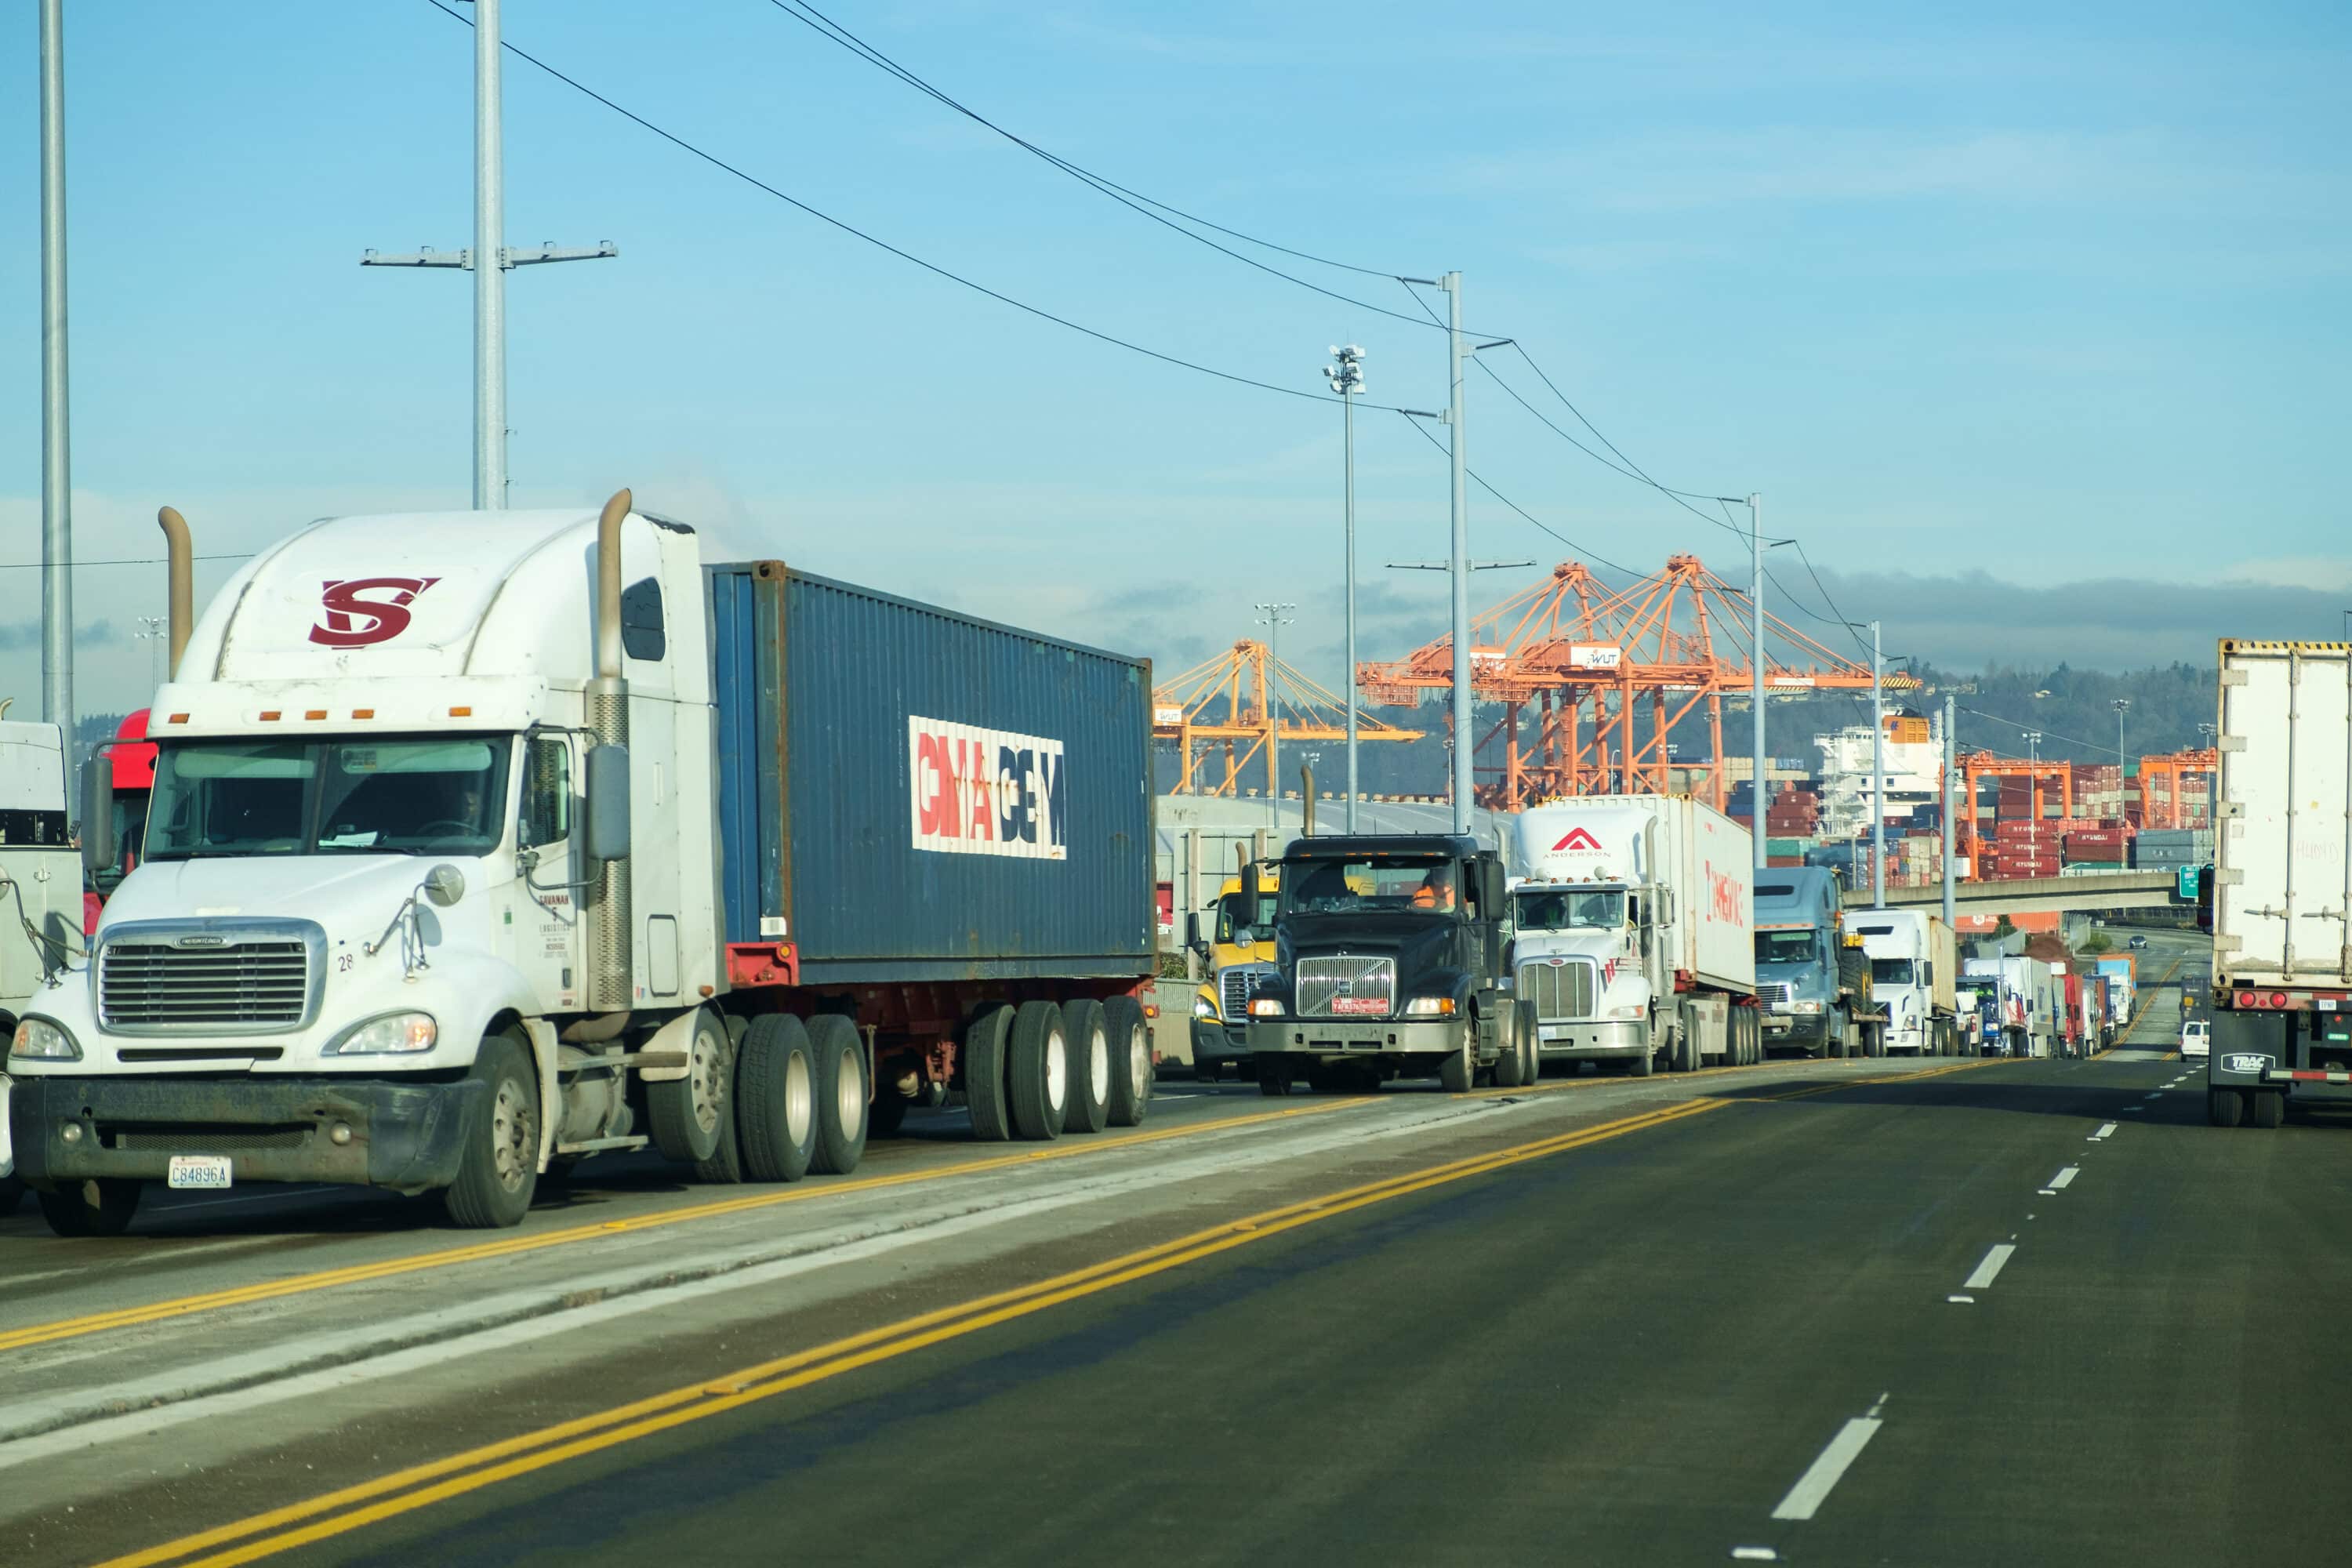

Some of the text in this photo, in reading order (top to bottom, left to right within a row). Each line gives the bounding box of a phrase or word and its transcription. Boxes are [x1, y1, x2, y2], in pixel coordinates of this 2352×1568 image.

[918, 732, 994, 841] CMA
[999, 745, 1065, 846] CGM
[1542, 851, 1611, 860] ANDERSON
[338, 953, 353, 972] 28
[2232, 1056, 2265, 1068] TRAC
